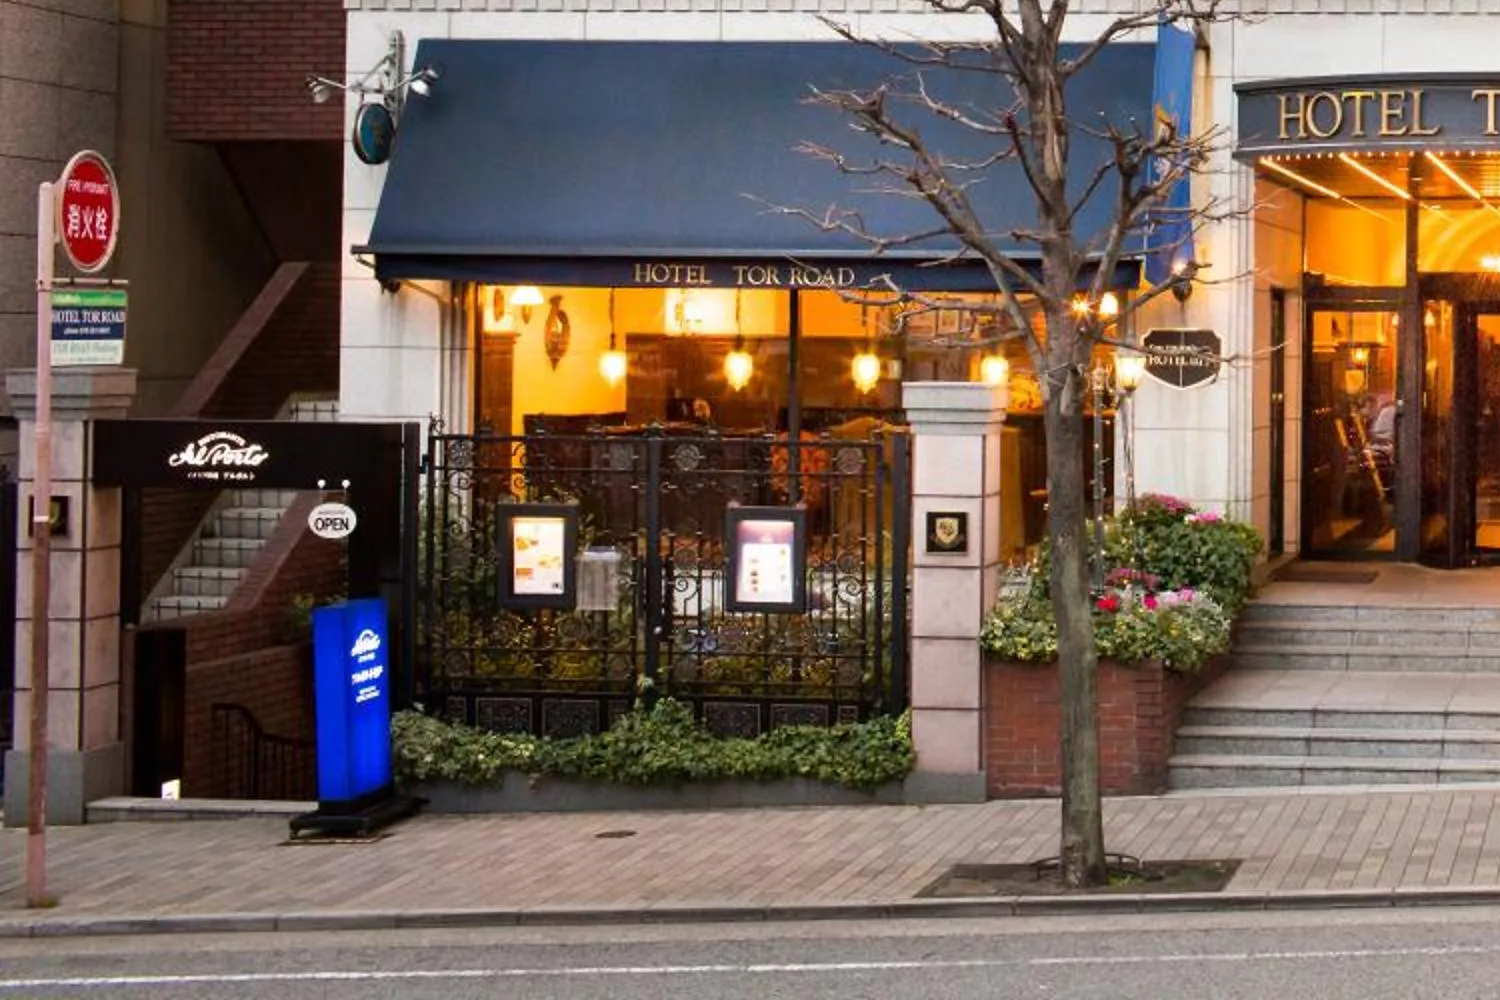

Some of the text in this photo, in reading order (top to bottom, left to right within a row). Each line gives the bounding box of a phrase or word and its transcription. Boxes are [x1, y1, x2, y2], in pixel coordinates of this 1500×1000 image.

[1279, 90, 1440, 139] HOTEL
[67, 203, 108, 240] 消火栓
[633, 263, 855, 286] HOTEL TOR ROAD
[315, 517, 349, 531] OPEN
